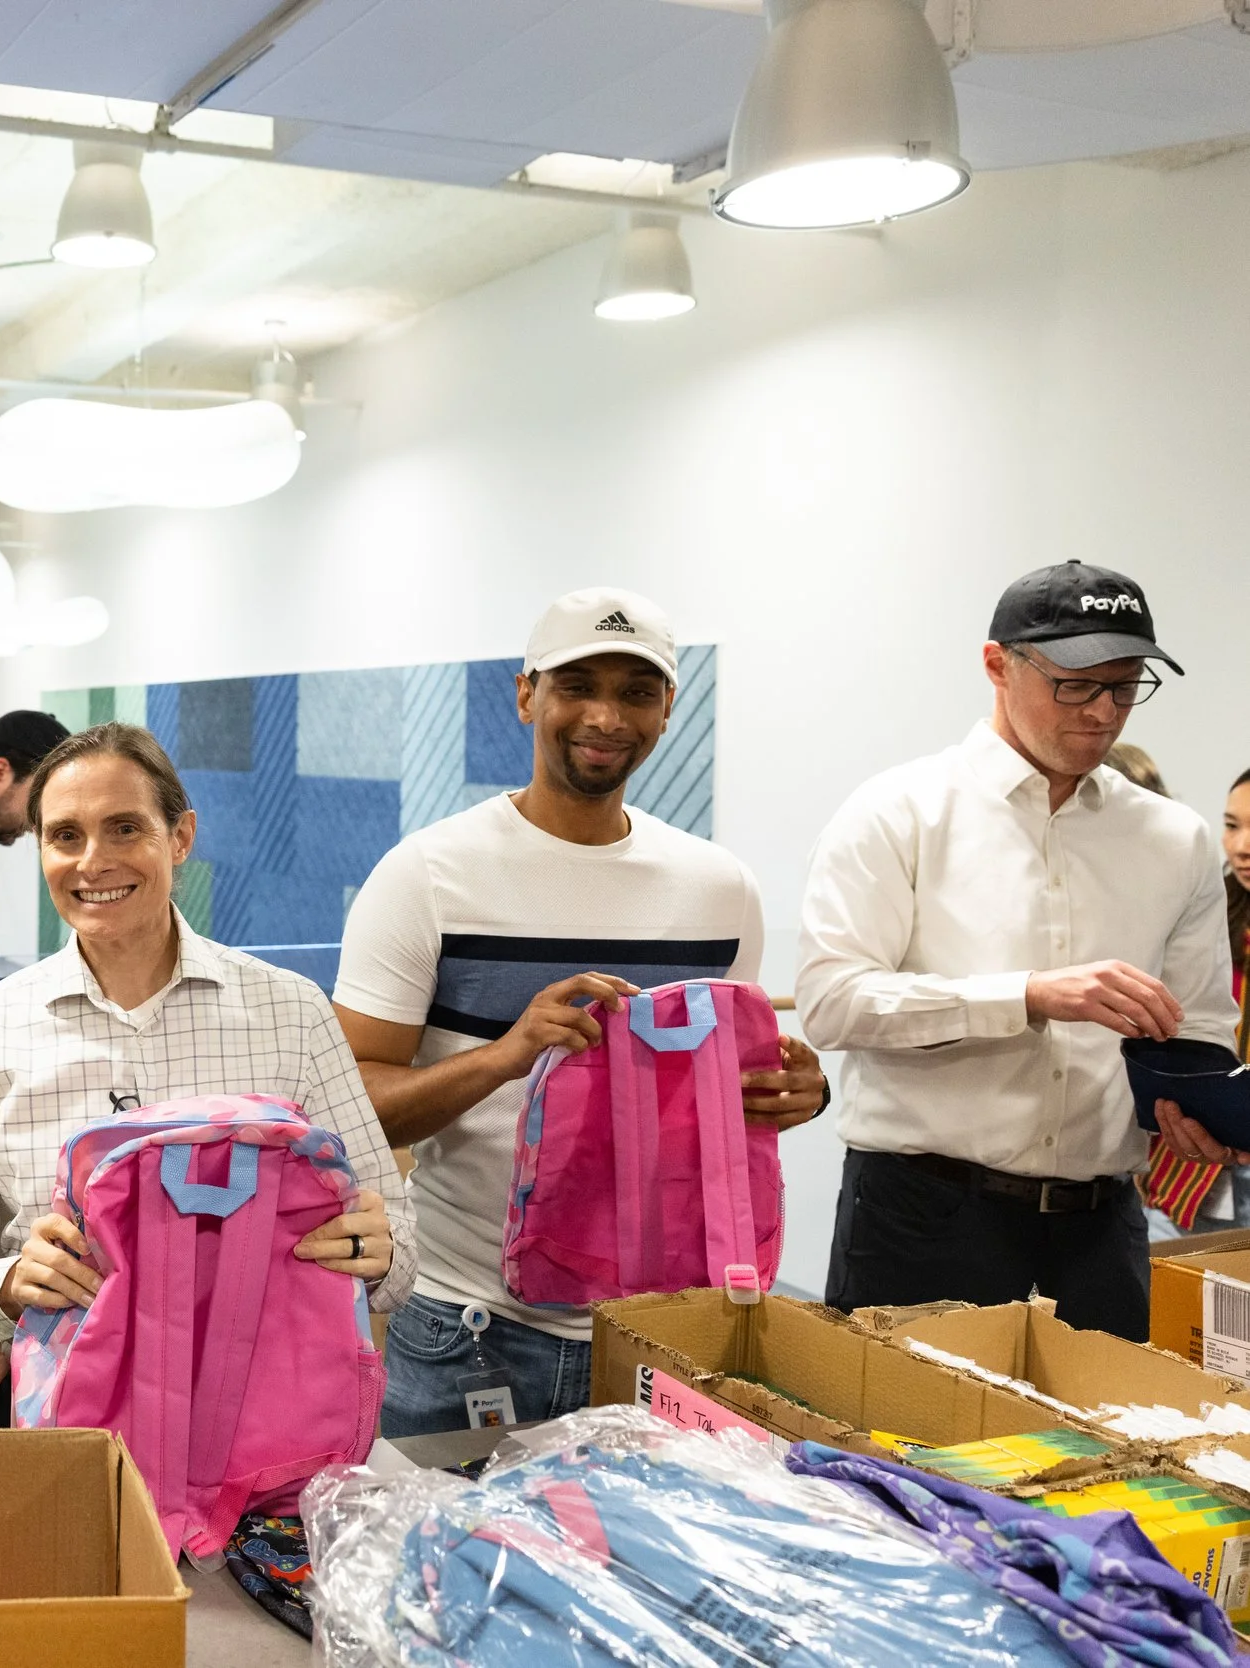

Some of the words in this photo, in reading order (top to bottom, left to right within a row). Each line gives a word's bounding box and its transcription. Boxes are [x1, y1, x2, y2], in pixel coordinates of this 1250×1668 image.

[1080, 594, 1142, 614] PayPal
[594, 621, 635, 634] adidas
[1203, 1547, 1215, 1592] rayons
